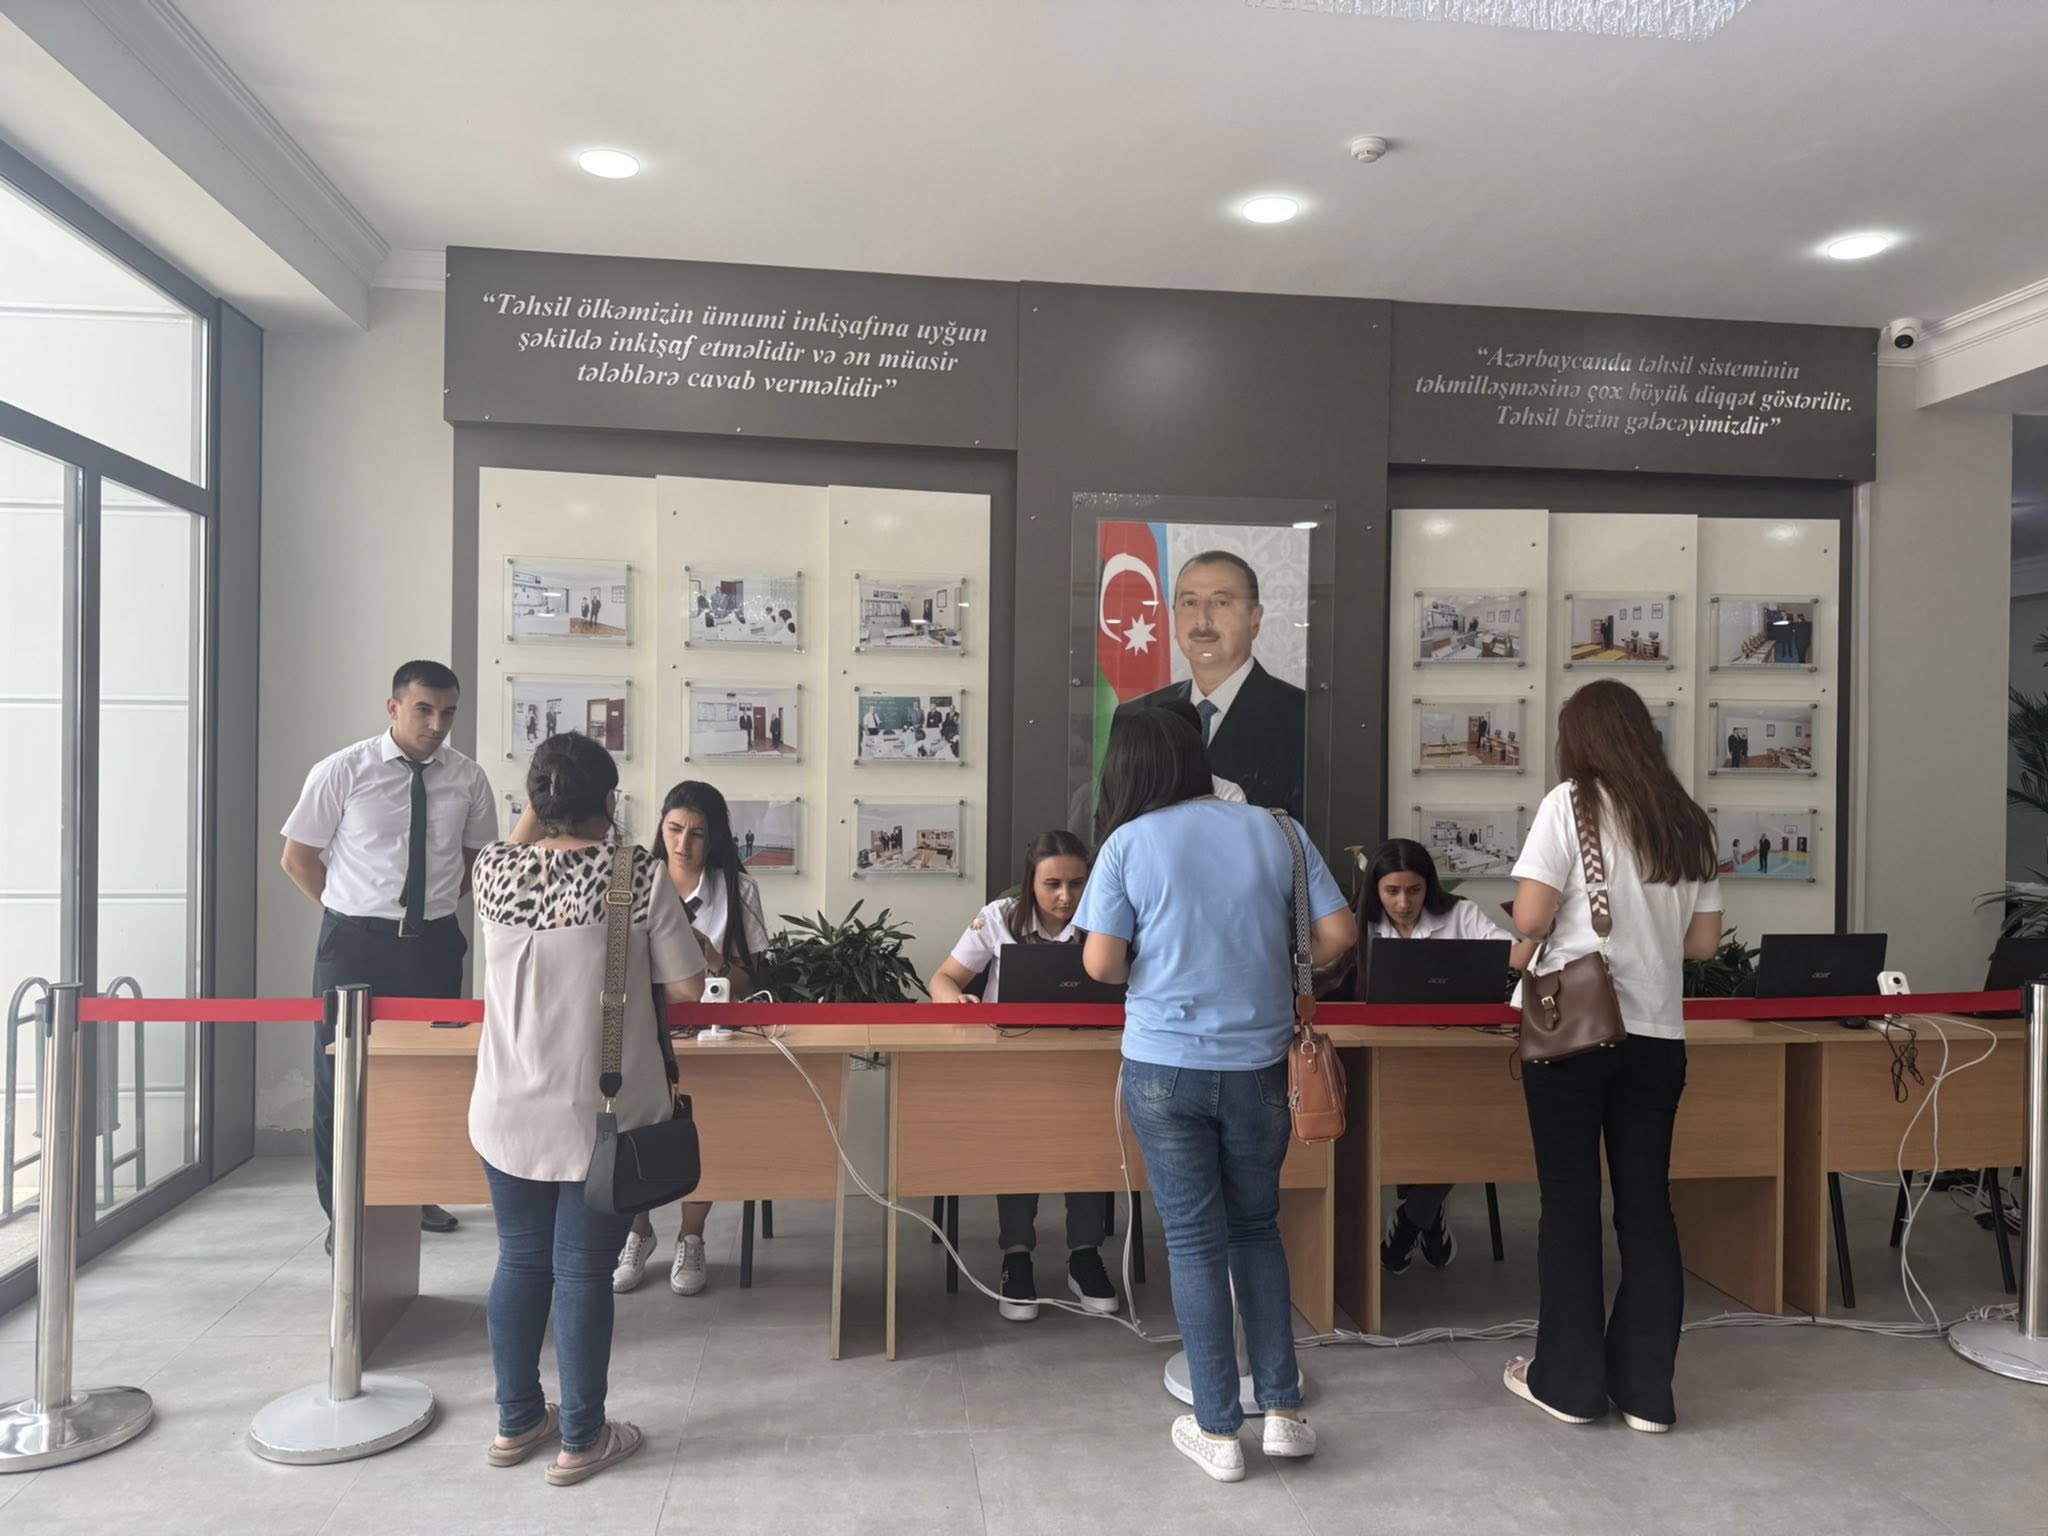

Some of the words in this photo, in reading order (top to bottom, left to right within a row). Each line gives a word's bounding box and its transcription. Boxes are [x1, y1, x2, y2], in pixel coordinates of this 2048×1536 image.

[482, 292, 573, 318] “Təhsil
[577, 297, 694, 326] ölkəmizin
[701, 305, 787, 330] ümumi
[792, 309, 910, 341] inkişafına
[916, 320, 988, 347] uyğun
[517, 327, 603, 352] şəkildə
[609, 330, 699, 362] inkişaf
[699, 338, 806, 362] etməlidir
[812, 348, 837, 365] və
[842, 350, 871, 367] ən
[878, 349, 959, 372] müasir
[576, 361, 680, 387] tələblərə
[687, 369, 756, 391] cavab
[763, 375, 898, 398] verməlidir”
